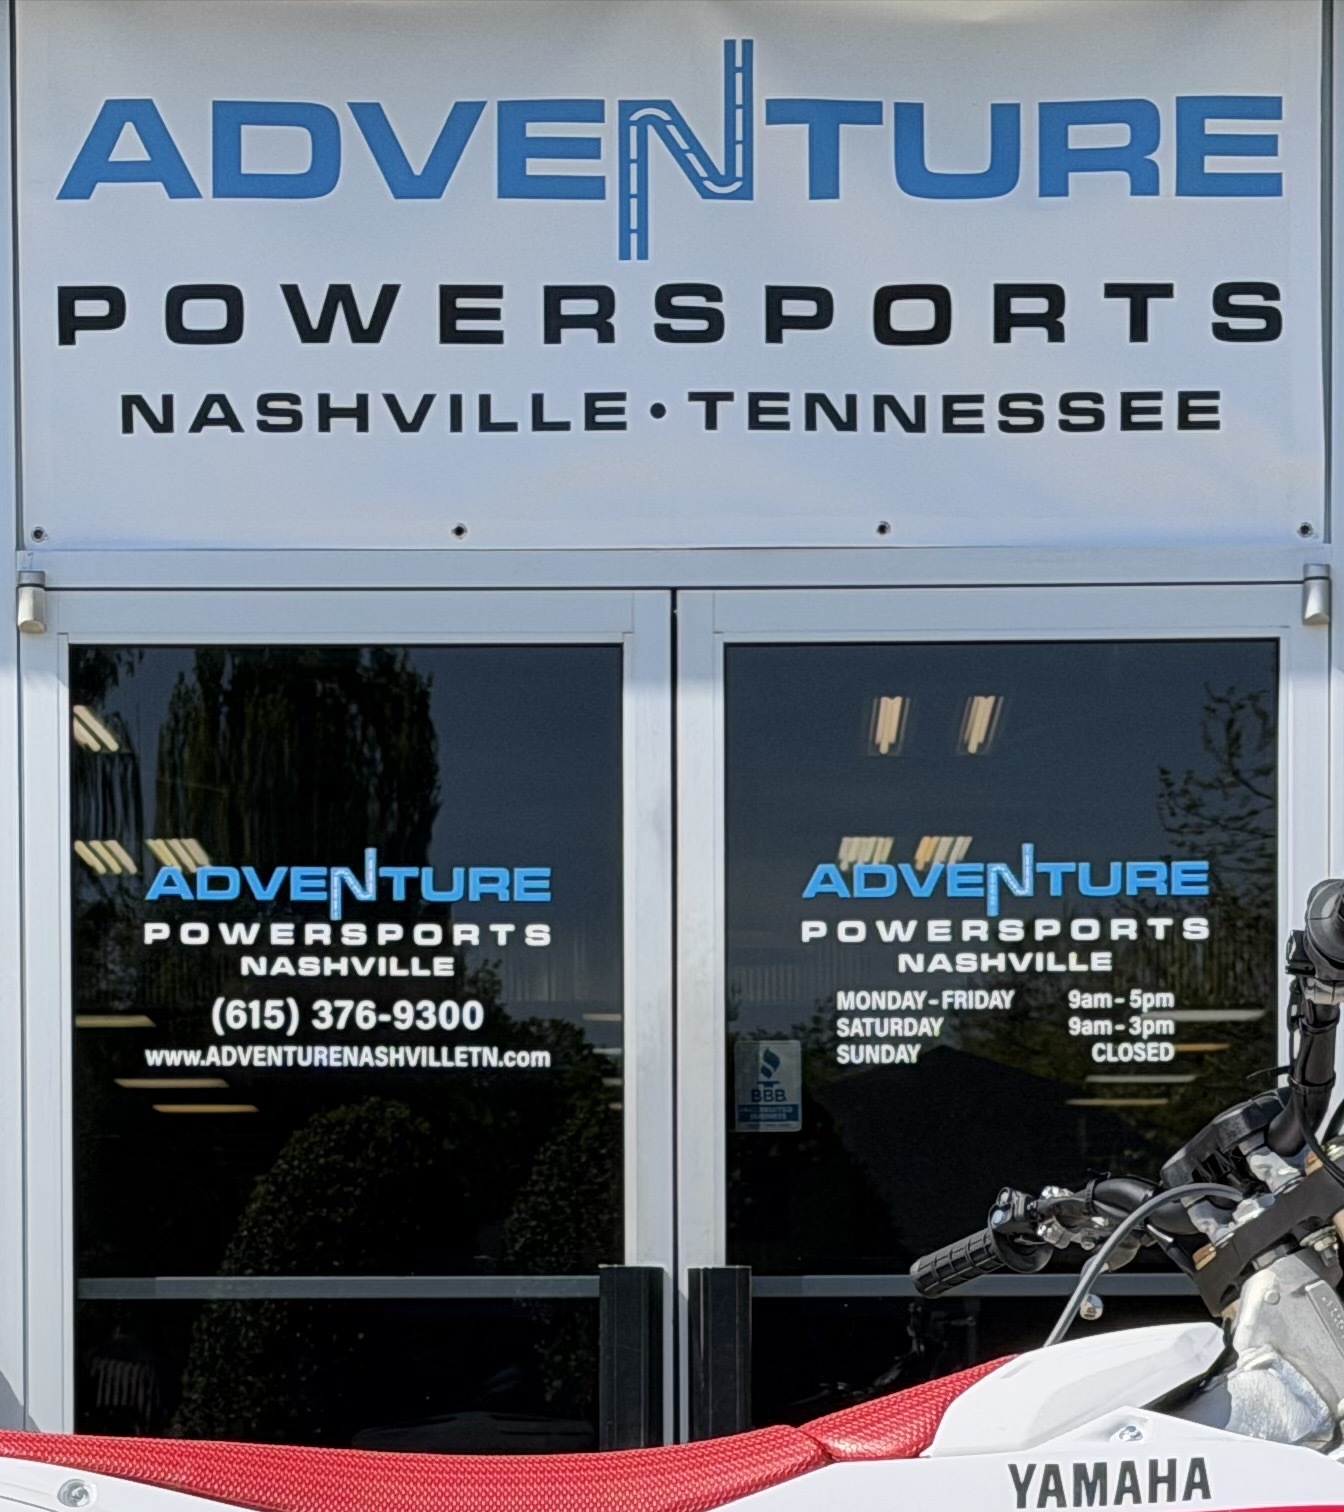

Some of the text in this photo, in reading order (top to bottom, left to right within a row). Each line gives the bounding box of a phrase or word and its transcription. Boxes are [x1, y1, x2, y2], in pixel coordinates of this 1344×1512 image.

[56, 39, 1284, 261] ADVENTURE
[57, 281, 1283, 346] POWERSPORTS
[145, 847, 552, 921] ADVENTURE
[801, 843, 1210, 917] ADVENTURE
[143, 922, 552, 947] POWERSPORTS
[801, 916, 1210, 943] POWERSPORTS
[240, 955, 455, 977] NASHVILLE
[897, 951, 1113, 973] NASHVILLE
[211, 996, 484, 1037] (615) 376-9300
[836, 1016, 945, 1038] SATURDAY
[144, 1045, 552, 1068] www.ADVENTURENASHVILLETN.com
[836, 1041, 1175, 1065] SUNDAY CLOSED
[751, 1088, 787, 1102] BBB
[1008, 1456, 1212, 1510] YAMAHA
